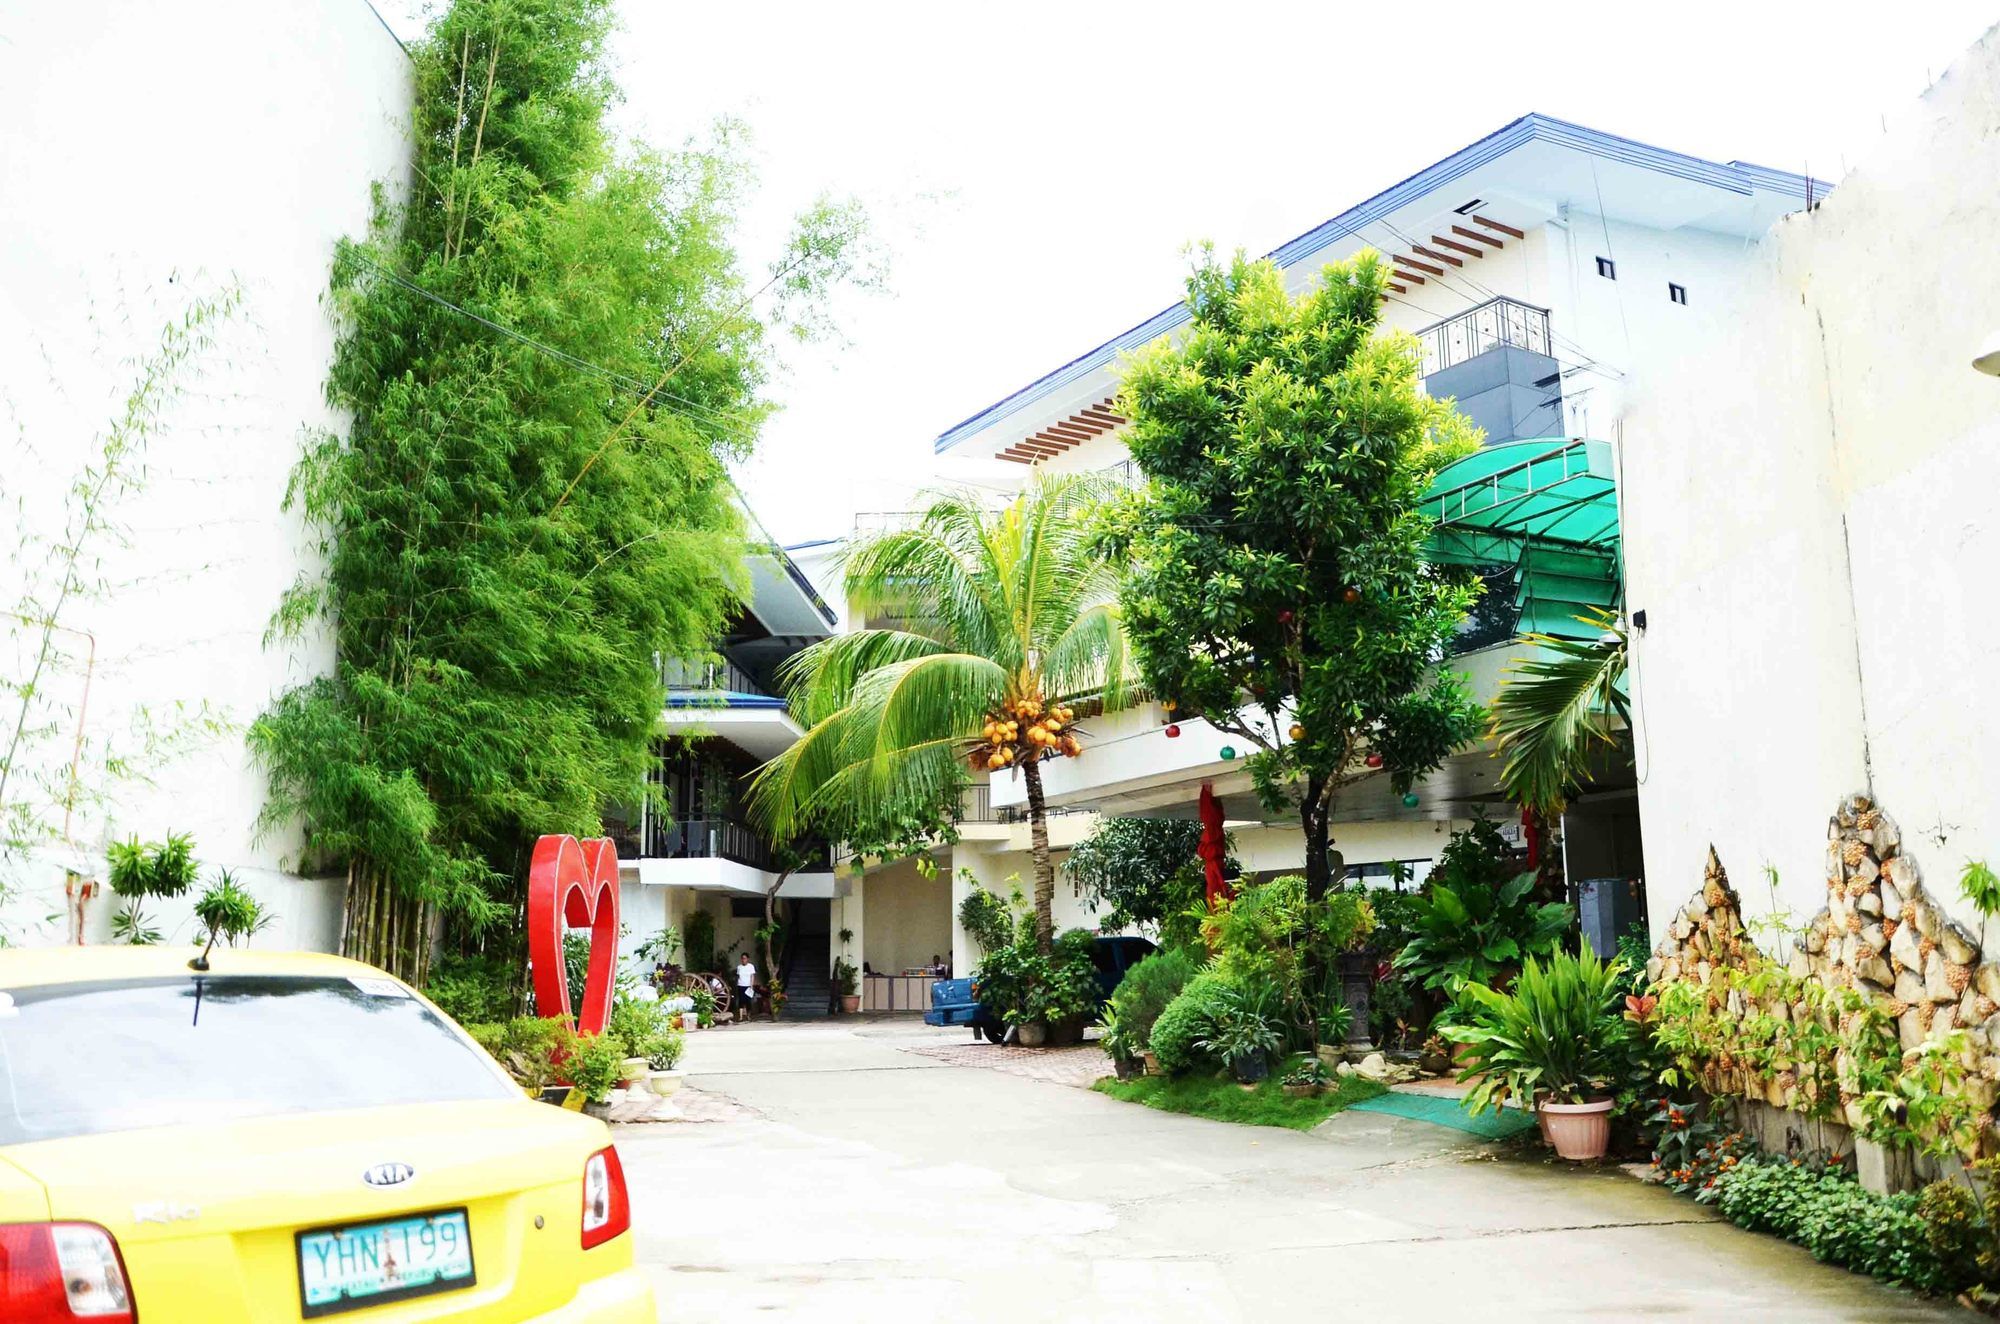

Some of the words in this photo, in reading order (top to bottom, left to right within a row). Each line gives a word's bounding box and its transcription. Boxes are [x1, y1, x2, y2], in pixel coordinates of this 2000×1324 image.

[370, 1164, 409, 1184] KIA
[313, 1233, 380, 1278] YHN
[403, 1222, 457, 1265] 199
